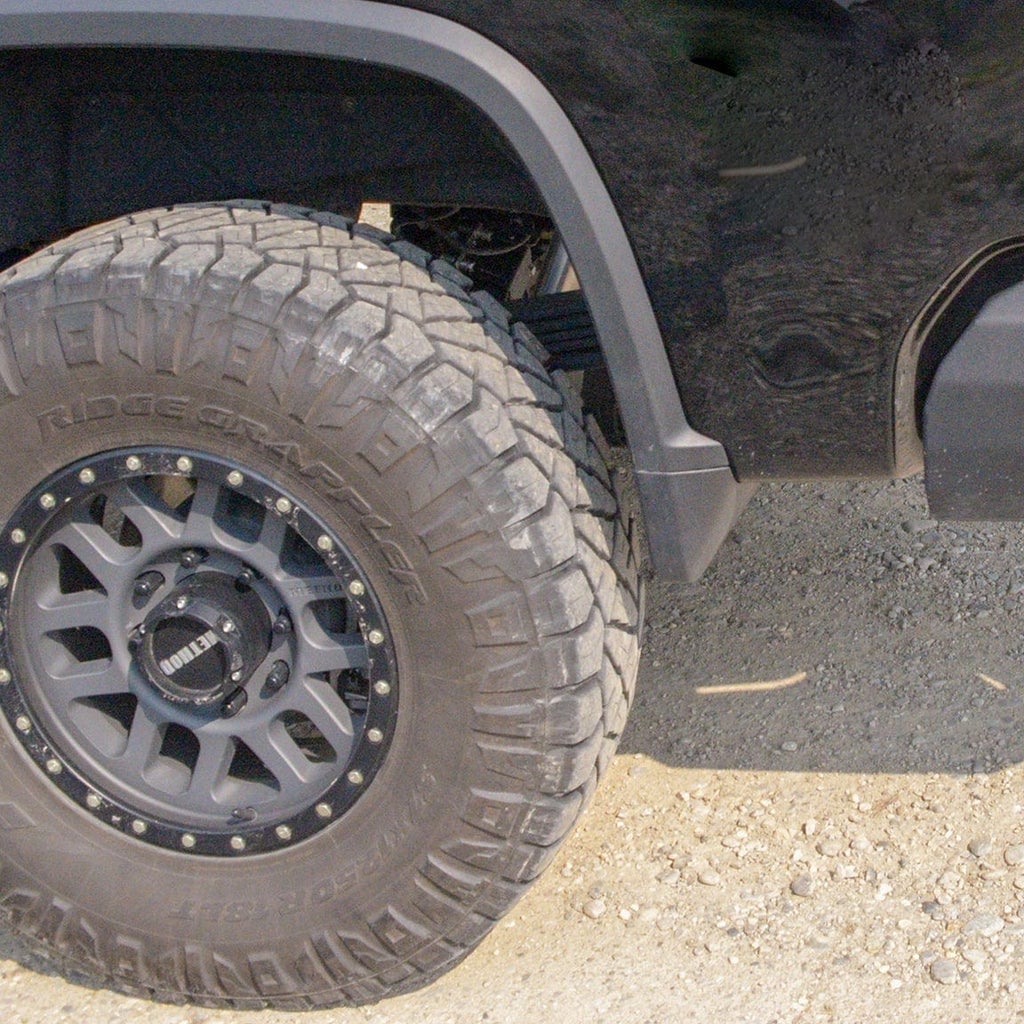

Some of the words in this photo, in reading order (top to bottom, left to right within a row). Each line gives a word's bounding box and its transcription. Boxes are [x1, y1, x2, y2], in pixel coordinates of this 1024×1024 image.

[37, 393, 190, 443] RIDGE
[198, 405, 429, 607] GRAPPLER
[159, 629, 219, 676] METHOD
